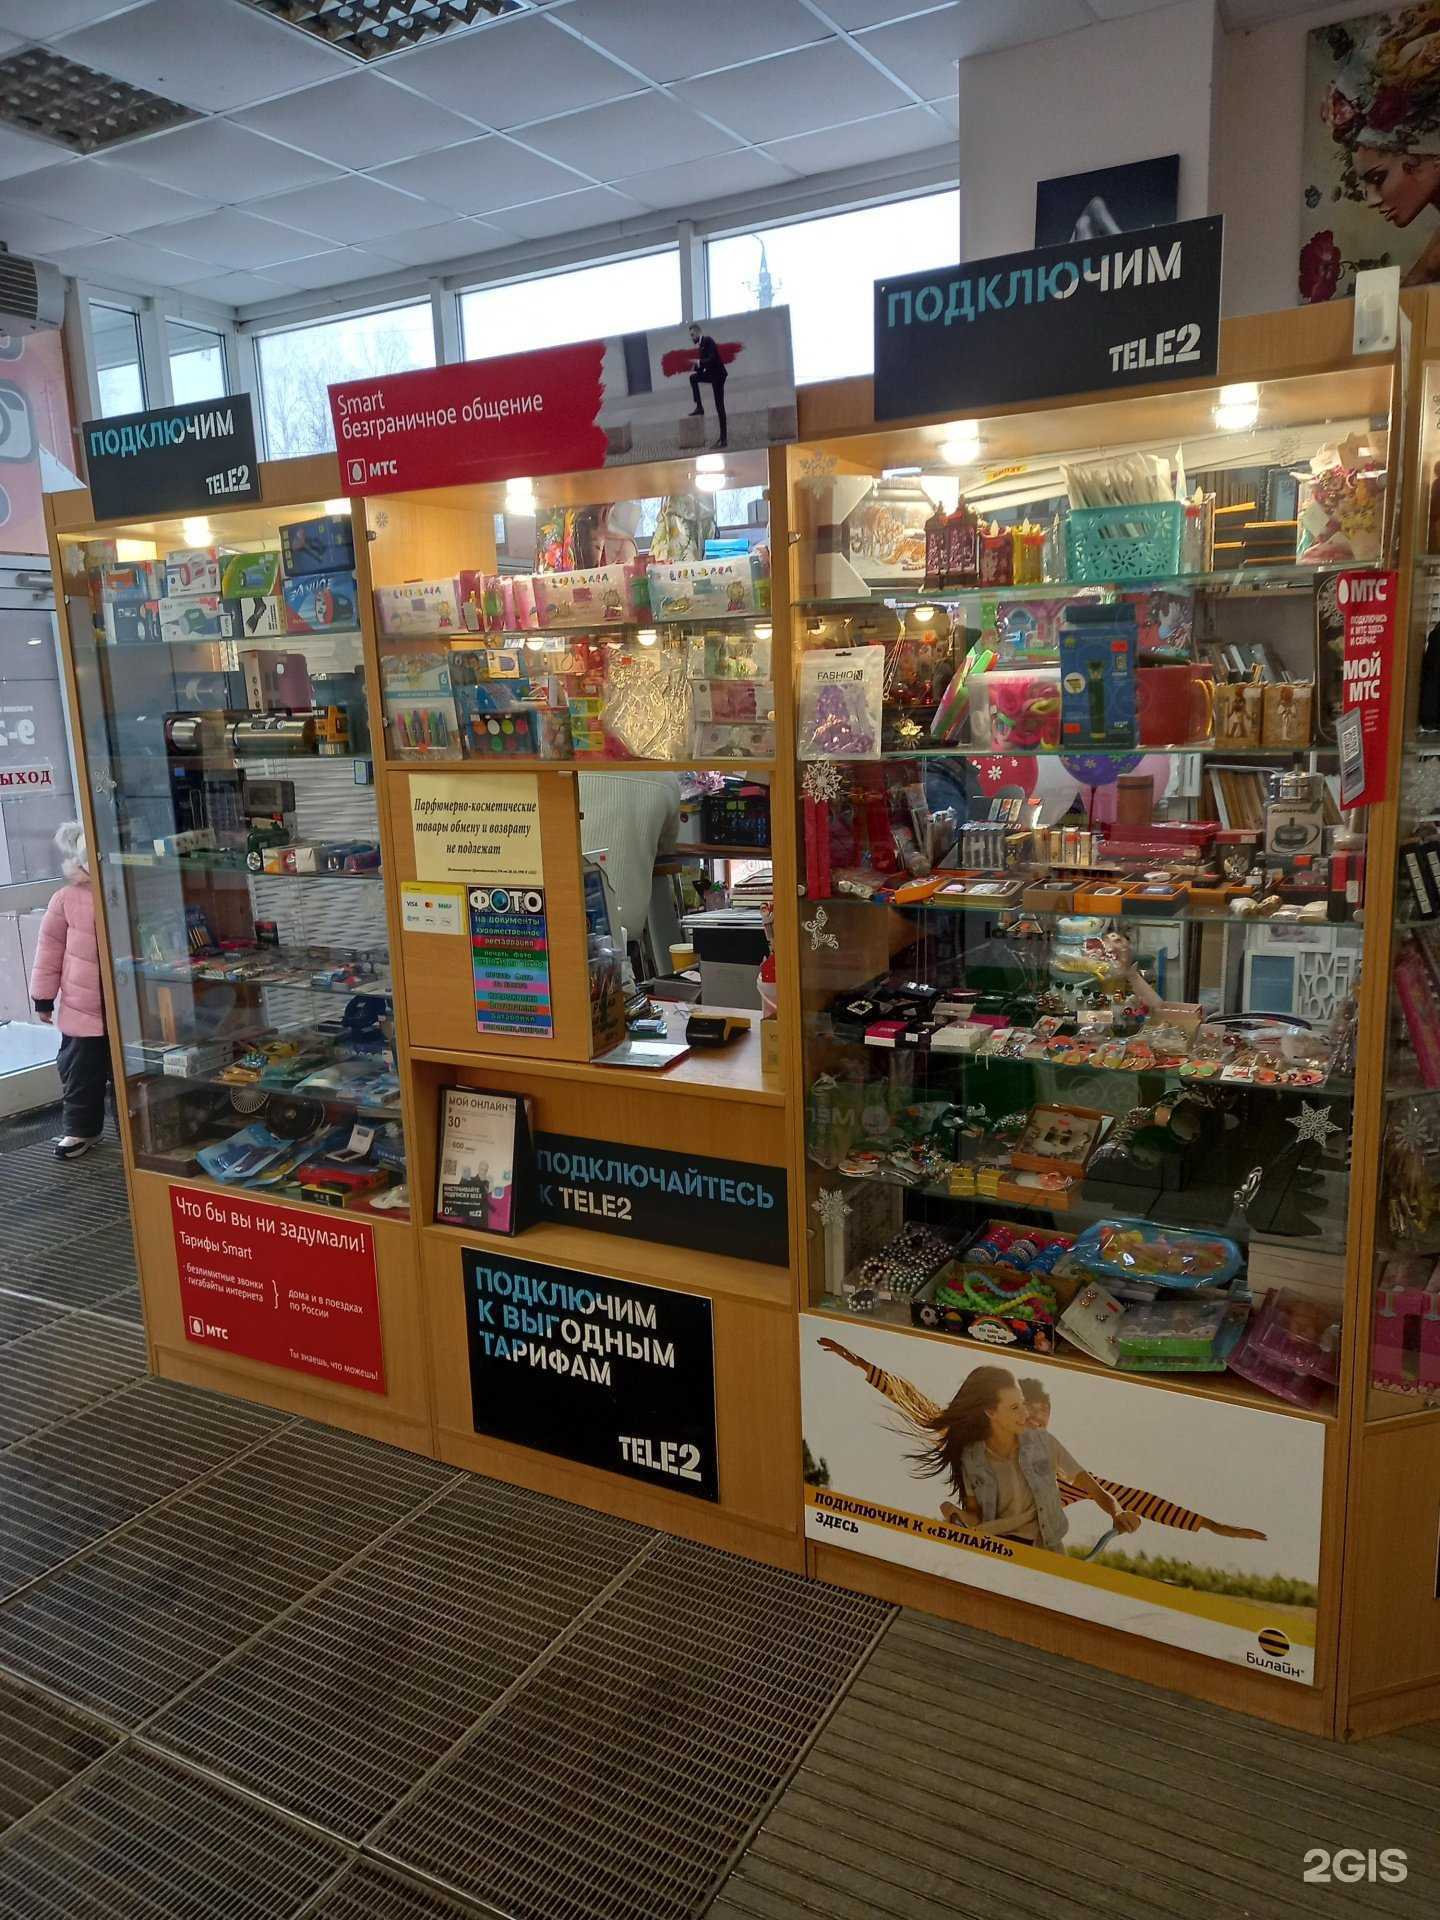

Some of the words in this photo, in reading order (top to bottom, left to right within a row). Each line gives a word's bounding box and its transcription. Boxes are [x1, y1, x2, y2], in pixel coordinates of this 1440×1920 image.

[888, 241, 1182, 327] ПОДКЛЮЧИМ
[1108, 323, 1202, 373] TELE2
[338, 391, 385, 416] Smart
[342, 407, 457, 440] безграничное
[462, 394, 543, 422] общение
[90, 409, 234, 457] ПОДКЛЮЧИМ
[205, 465, 251, 496] TELE2
[369, 460, 398, 477] МТС
[1351, 579, 1387, 602] МТС
[817, 669, 863, 681] FASHION
[1343, 651, 1381, 680] МОЙ
[1350, 679, 1380, 702] МТС
[0, 770, 51, 785] ЫХОД
[414, 798, 536, 815] Парфюмерно-косметические
[416, 821, 448, 835] товары
[450, 820, 480, 836] обмену
[482, 825, 487, 833] и
[489, 824, 531, 837] возврату
[446, 845, 456, 854] не
[458, 841, 501, 855] подлежат
[470, 888, 542, 913] ФОТО
[1299, 997, 1340, 1020] LOV
[448, 1095, 468, 1106] МОЙ
[471, 1099, 508, 1112] ОНЛАЙН
[448, 1116, 461, 1128] 30
[537, 1151, 774, 1208] ПОДКЛЮЧАЙТЕСЬ
[540, 1184, 554, 1206] К
[559, 1186, 632, 1220] TELE2
[176, 1196, 201, 1218] Что
[205, 1202, 226, 1224] бы
[231, 1211, 251, 1229] вы
[256, 1217, 275, 1234] ни
[280, 1221, 366, 1254] задумали!
[179, 1231, 220, 1253] Тарифы
[222, 1240, 253, 1260] Smart
[186, 1263, 236, 1285] безлимитные
[237, 1274, 264, 1290] звонки
[188, 1276, 224, 1294] гигабайты
[225, 1285, 264, 1303] интернета
[288, 1288, 310, 1302] дома
[311, 1293, 317, 1303] и
[318, 1296, 324, 1305] в
[325, 1298, 363, 1315] поездках
[289, 1301, 300, 1311] по
[301, 1303, 329, 1319] России
[475, 1266, 657, 1330] ПОДКЛЮЧИМ
[206, 1324, 229, 1340] МТС
[478, 1298, 495, 1325] К
[503, 1304, 675, 1369] ВЫГОДНЫМ
[290, 1348, 300, 1359] Ты
[301, 1353, 329, 1369] знаешь,
[330, 1361, 343, 1372] что
[344, 1364, 378, 1381] можешь!
[479, 1331, 612, 1386] ТАРИФАМ
[618, 1435, 702, 1482] TELE2
[815, 1491, 909, 1529] ПОДКЛЮЧИМ
[912, 1519, 924, 1533] К
[927, 1526, 1014, 1557] «БИЛАЙН»
[816, 1511, 859, 1534] ЗДЕСЬ
[1246, 1651, 1301, 1677] Билайн
